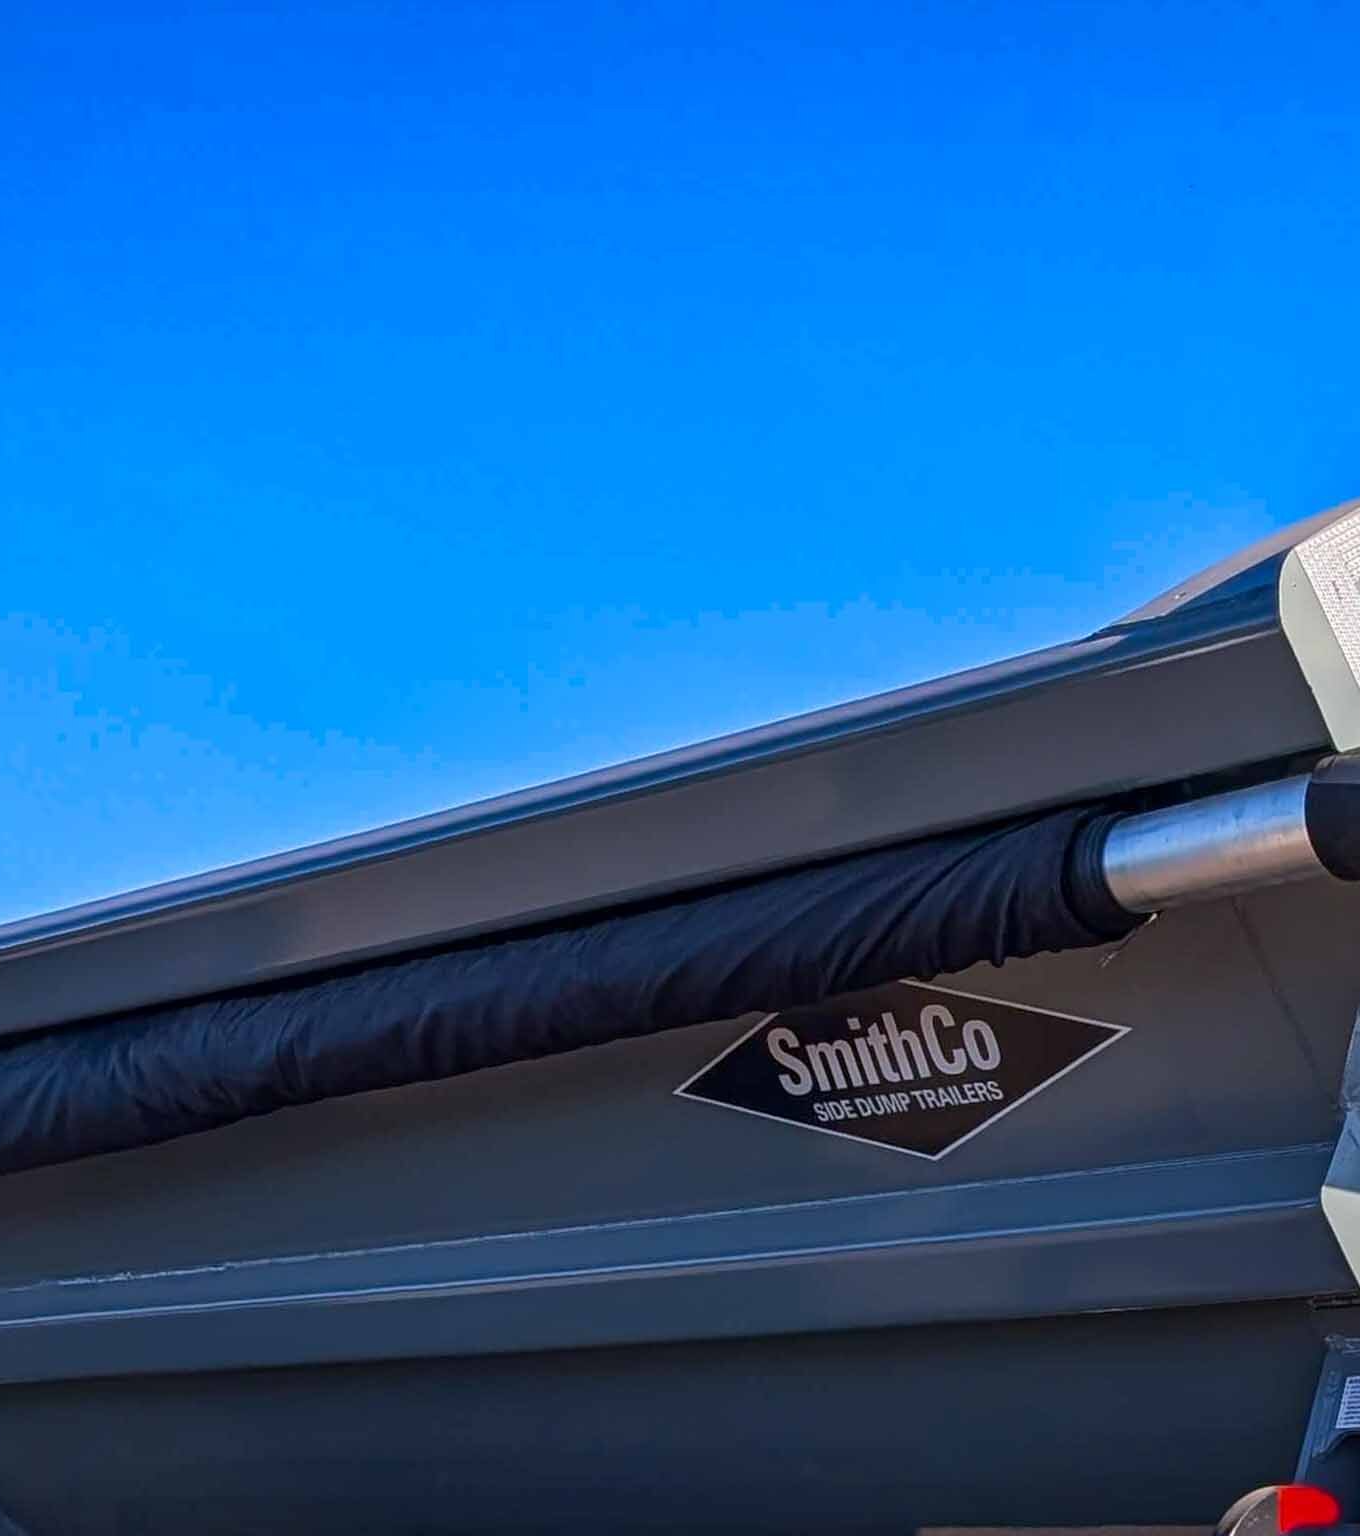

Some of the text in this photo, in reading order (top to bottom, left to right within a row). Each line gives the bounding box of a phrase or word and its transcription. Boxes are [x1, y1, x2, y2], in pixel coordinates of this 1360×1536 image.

[768, 1004, 1002, 1097] SmithCo
[813, 1081, 1003, 1123] SIDE DUMP TRAILERS
